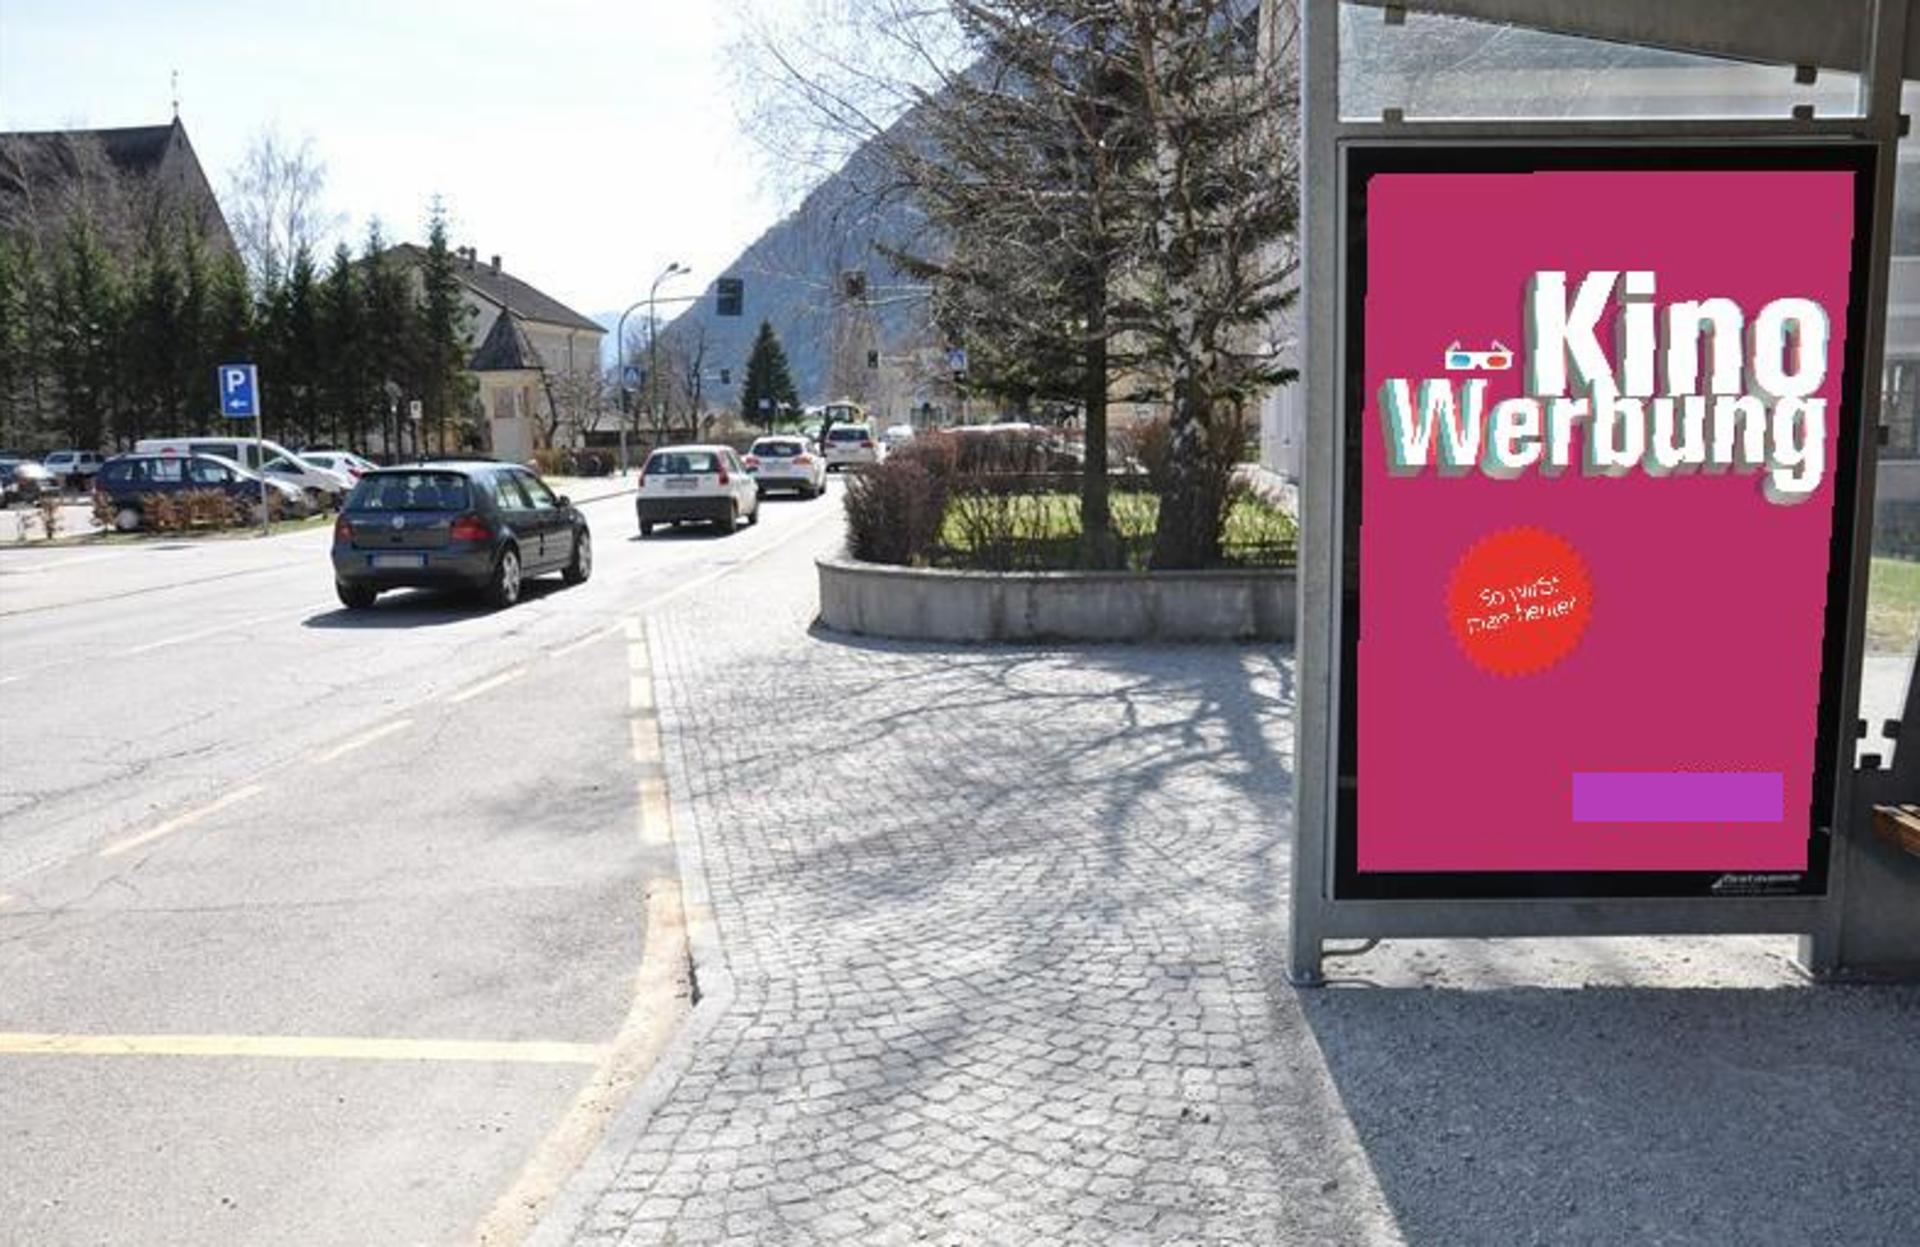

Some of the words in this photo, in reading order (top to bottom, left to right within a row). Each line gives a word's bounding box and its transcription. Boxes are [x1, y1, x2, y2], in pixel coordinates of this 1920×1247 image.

[227, 370, 245, 393] P
[1528, 270, 1829, 400] Kino
[1382, 378, 1828, 498] Werbung
